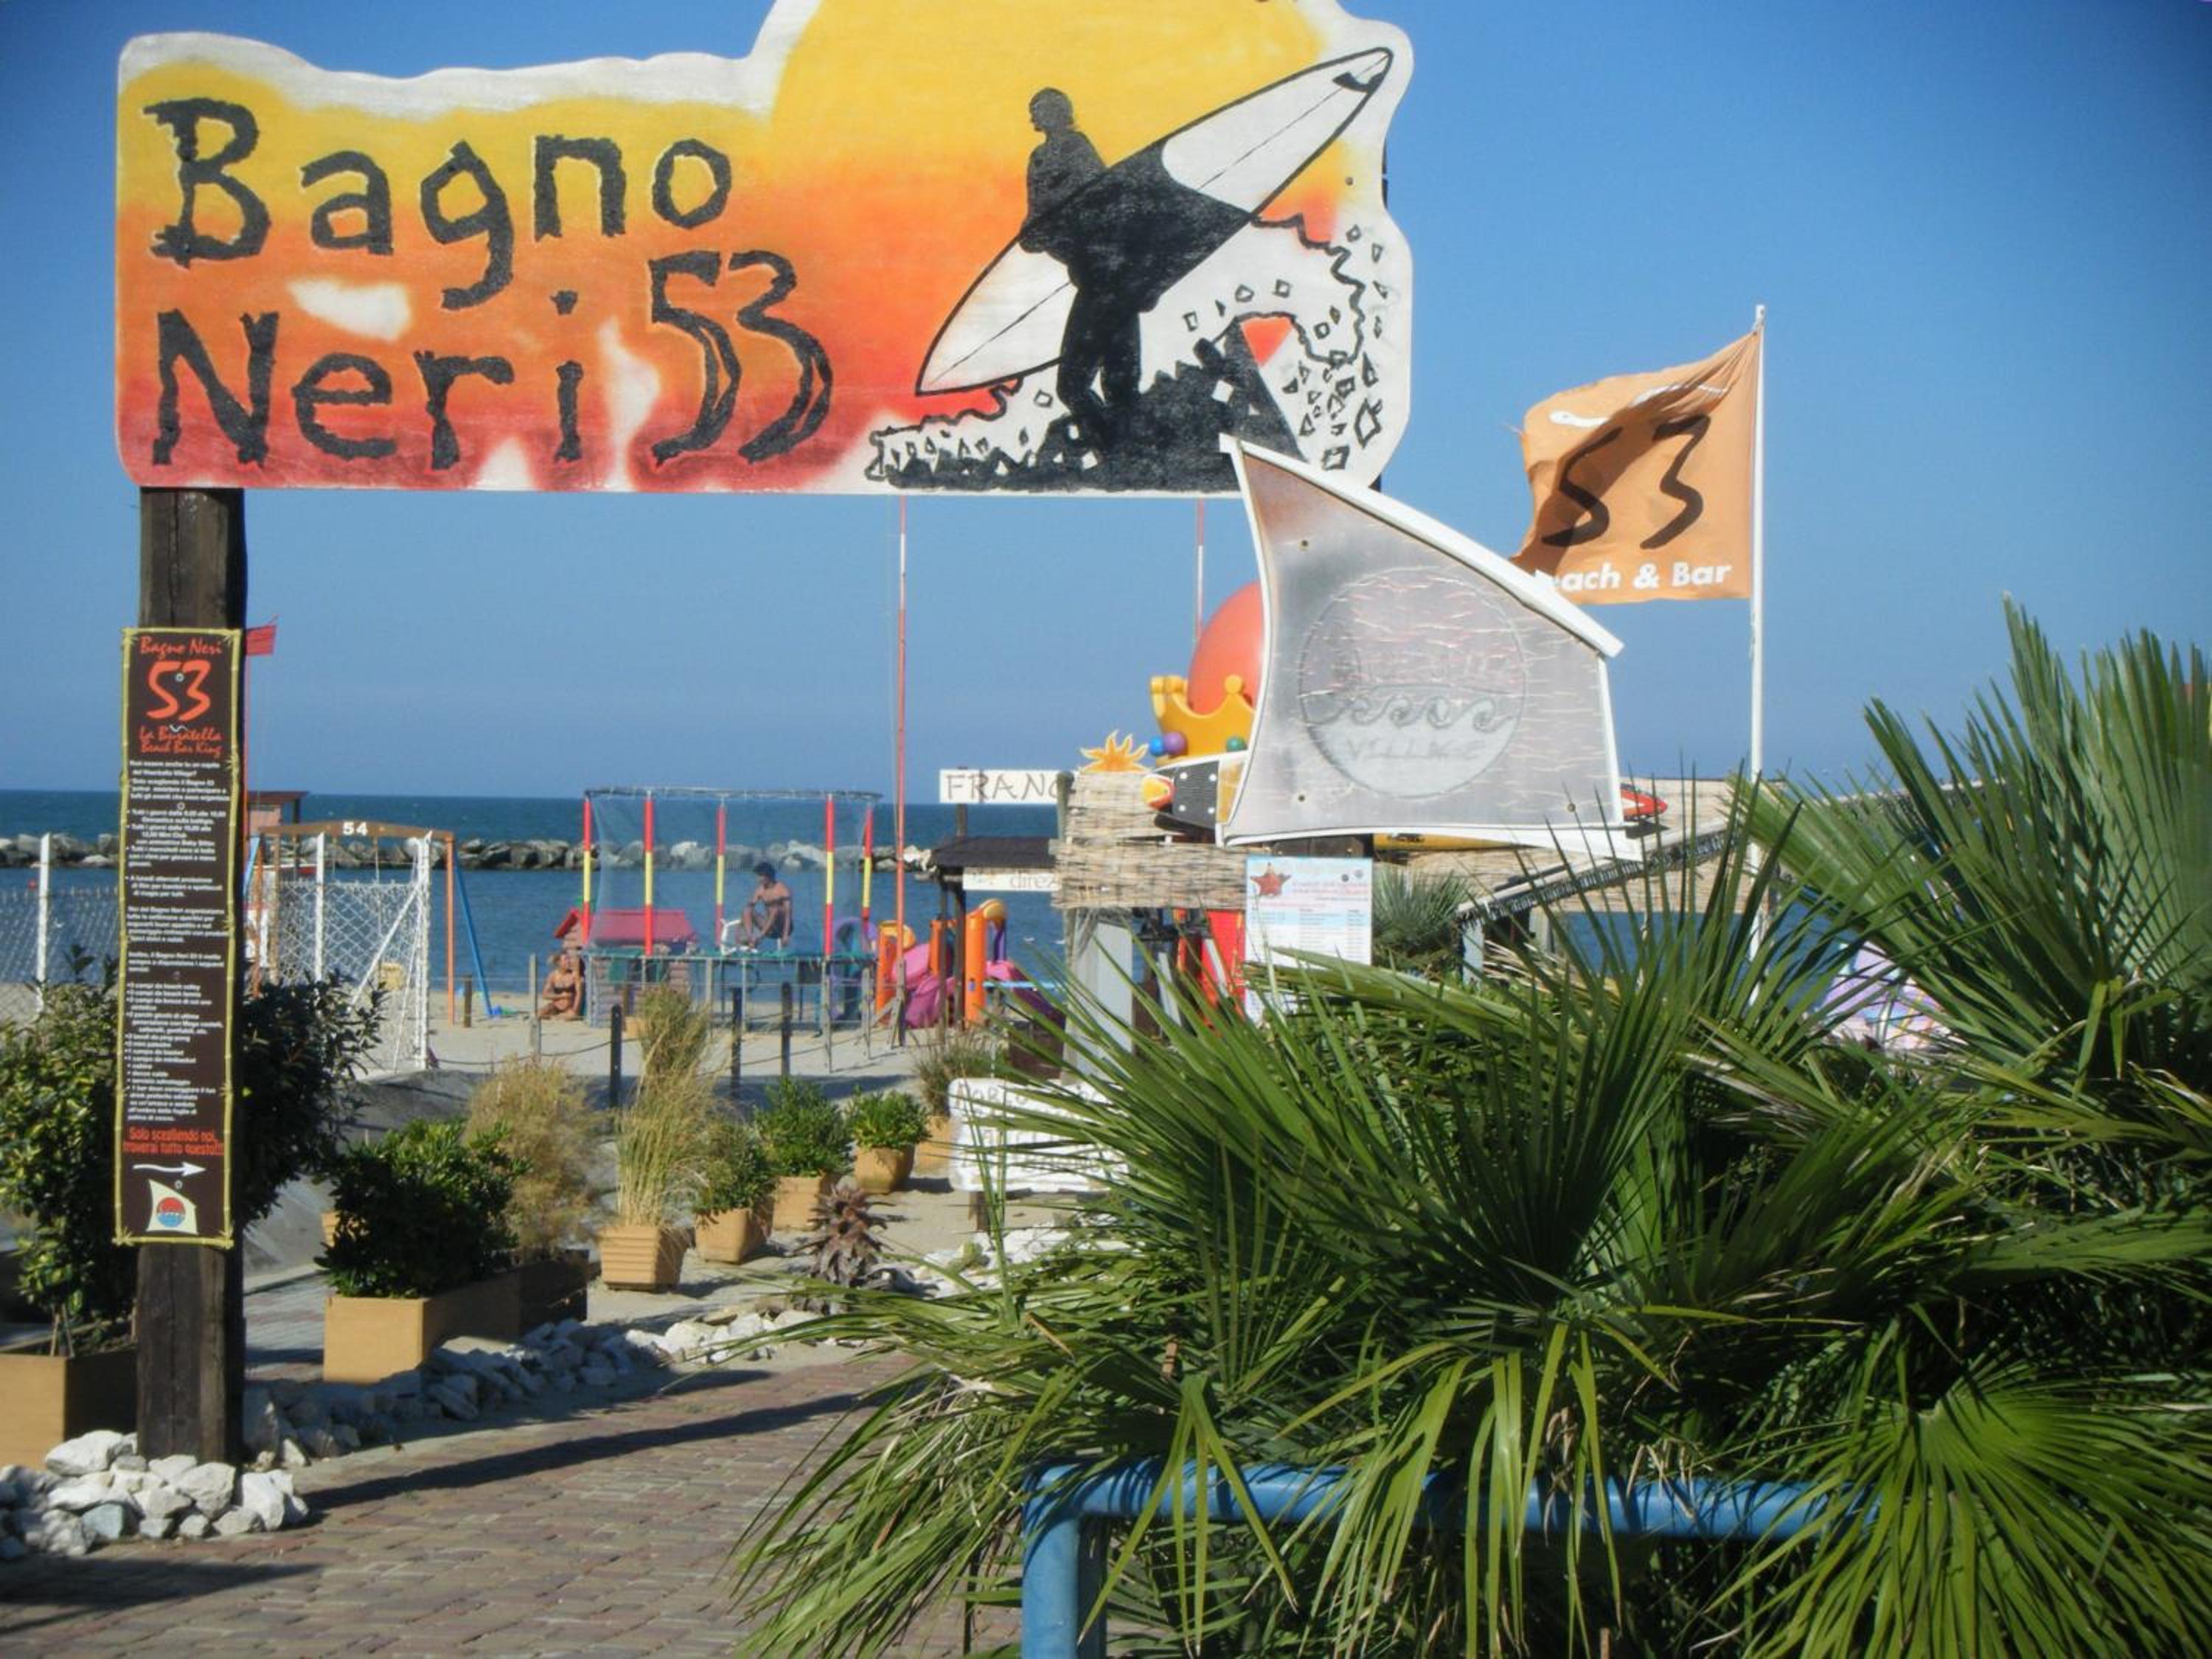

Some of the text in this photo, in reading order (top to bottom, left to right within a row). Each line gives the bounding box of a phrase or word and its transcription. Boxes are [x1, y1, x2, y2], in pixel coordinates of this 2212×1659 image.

[142, 97, 732, 310] Bagno
[153, 249, 834, 468] Neri 53
[1632, 562, 1660, 588] &
[1672, 560, 1732, 587] Bar
[146, 659, 212, 722] 53
[342, 821, 368, 836] 54
